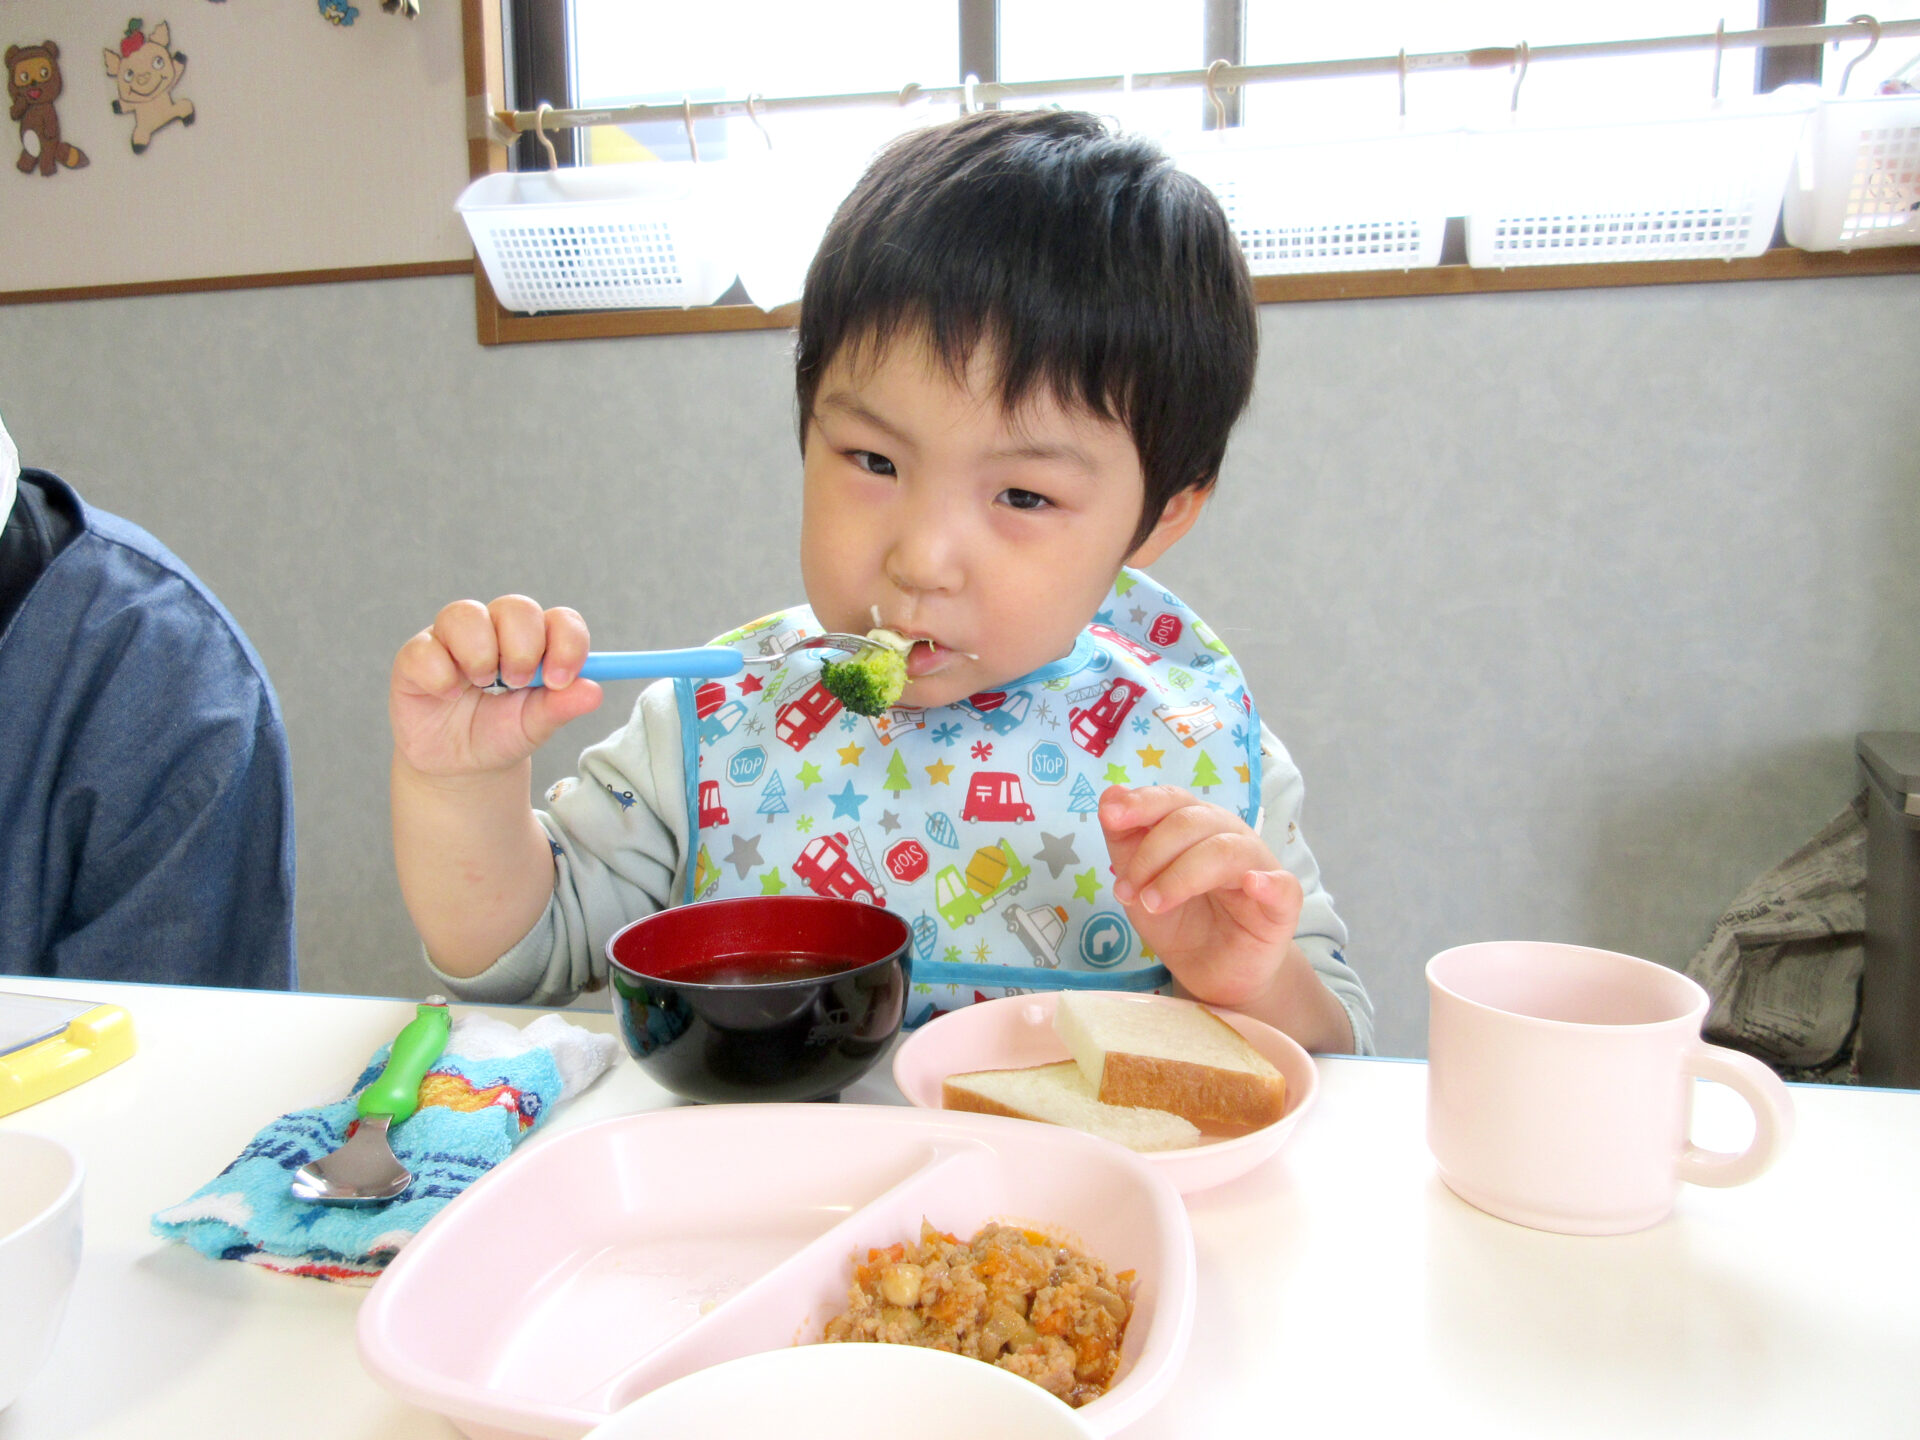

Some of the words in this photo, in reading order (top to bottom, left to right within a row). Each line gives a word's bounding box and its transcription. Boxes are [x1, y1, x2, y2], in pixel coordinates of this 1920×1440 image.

[1155, 617, 1175, 643] STOP
[732, 757, 762, 776] STOP
[1035, 753, 1063, 774] STOP
[893, 845, 923, 875] STOP
